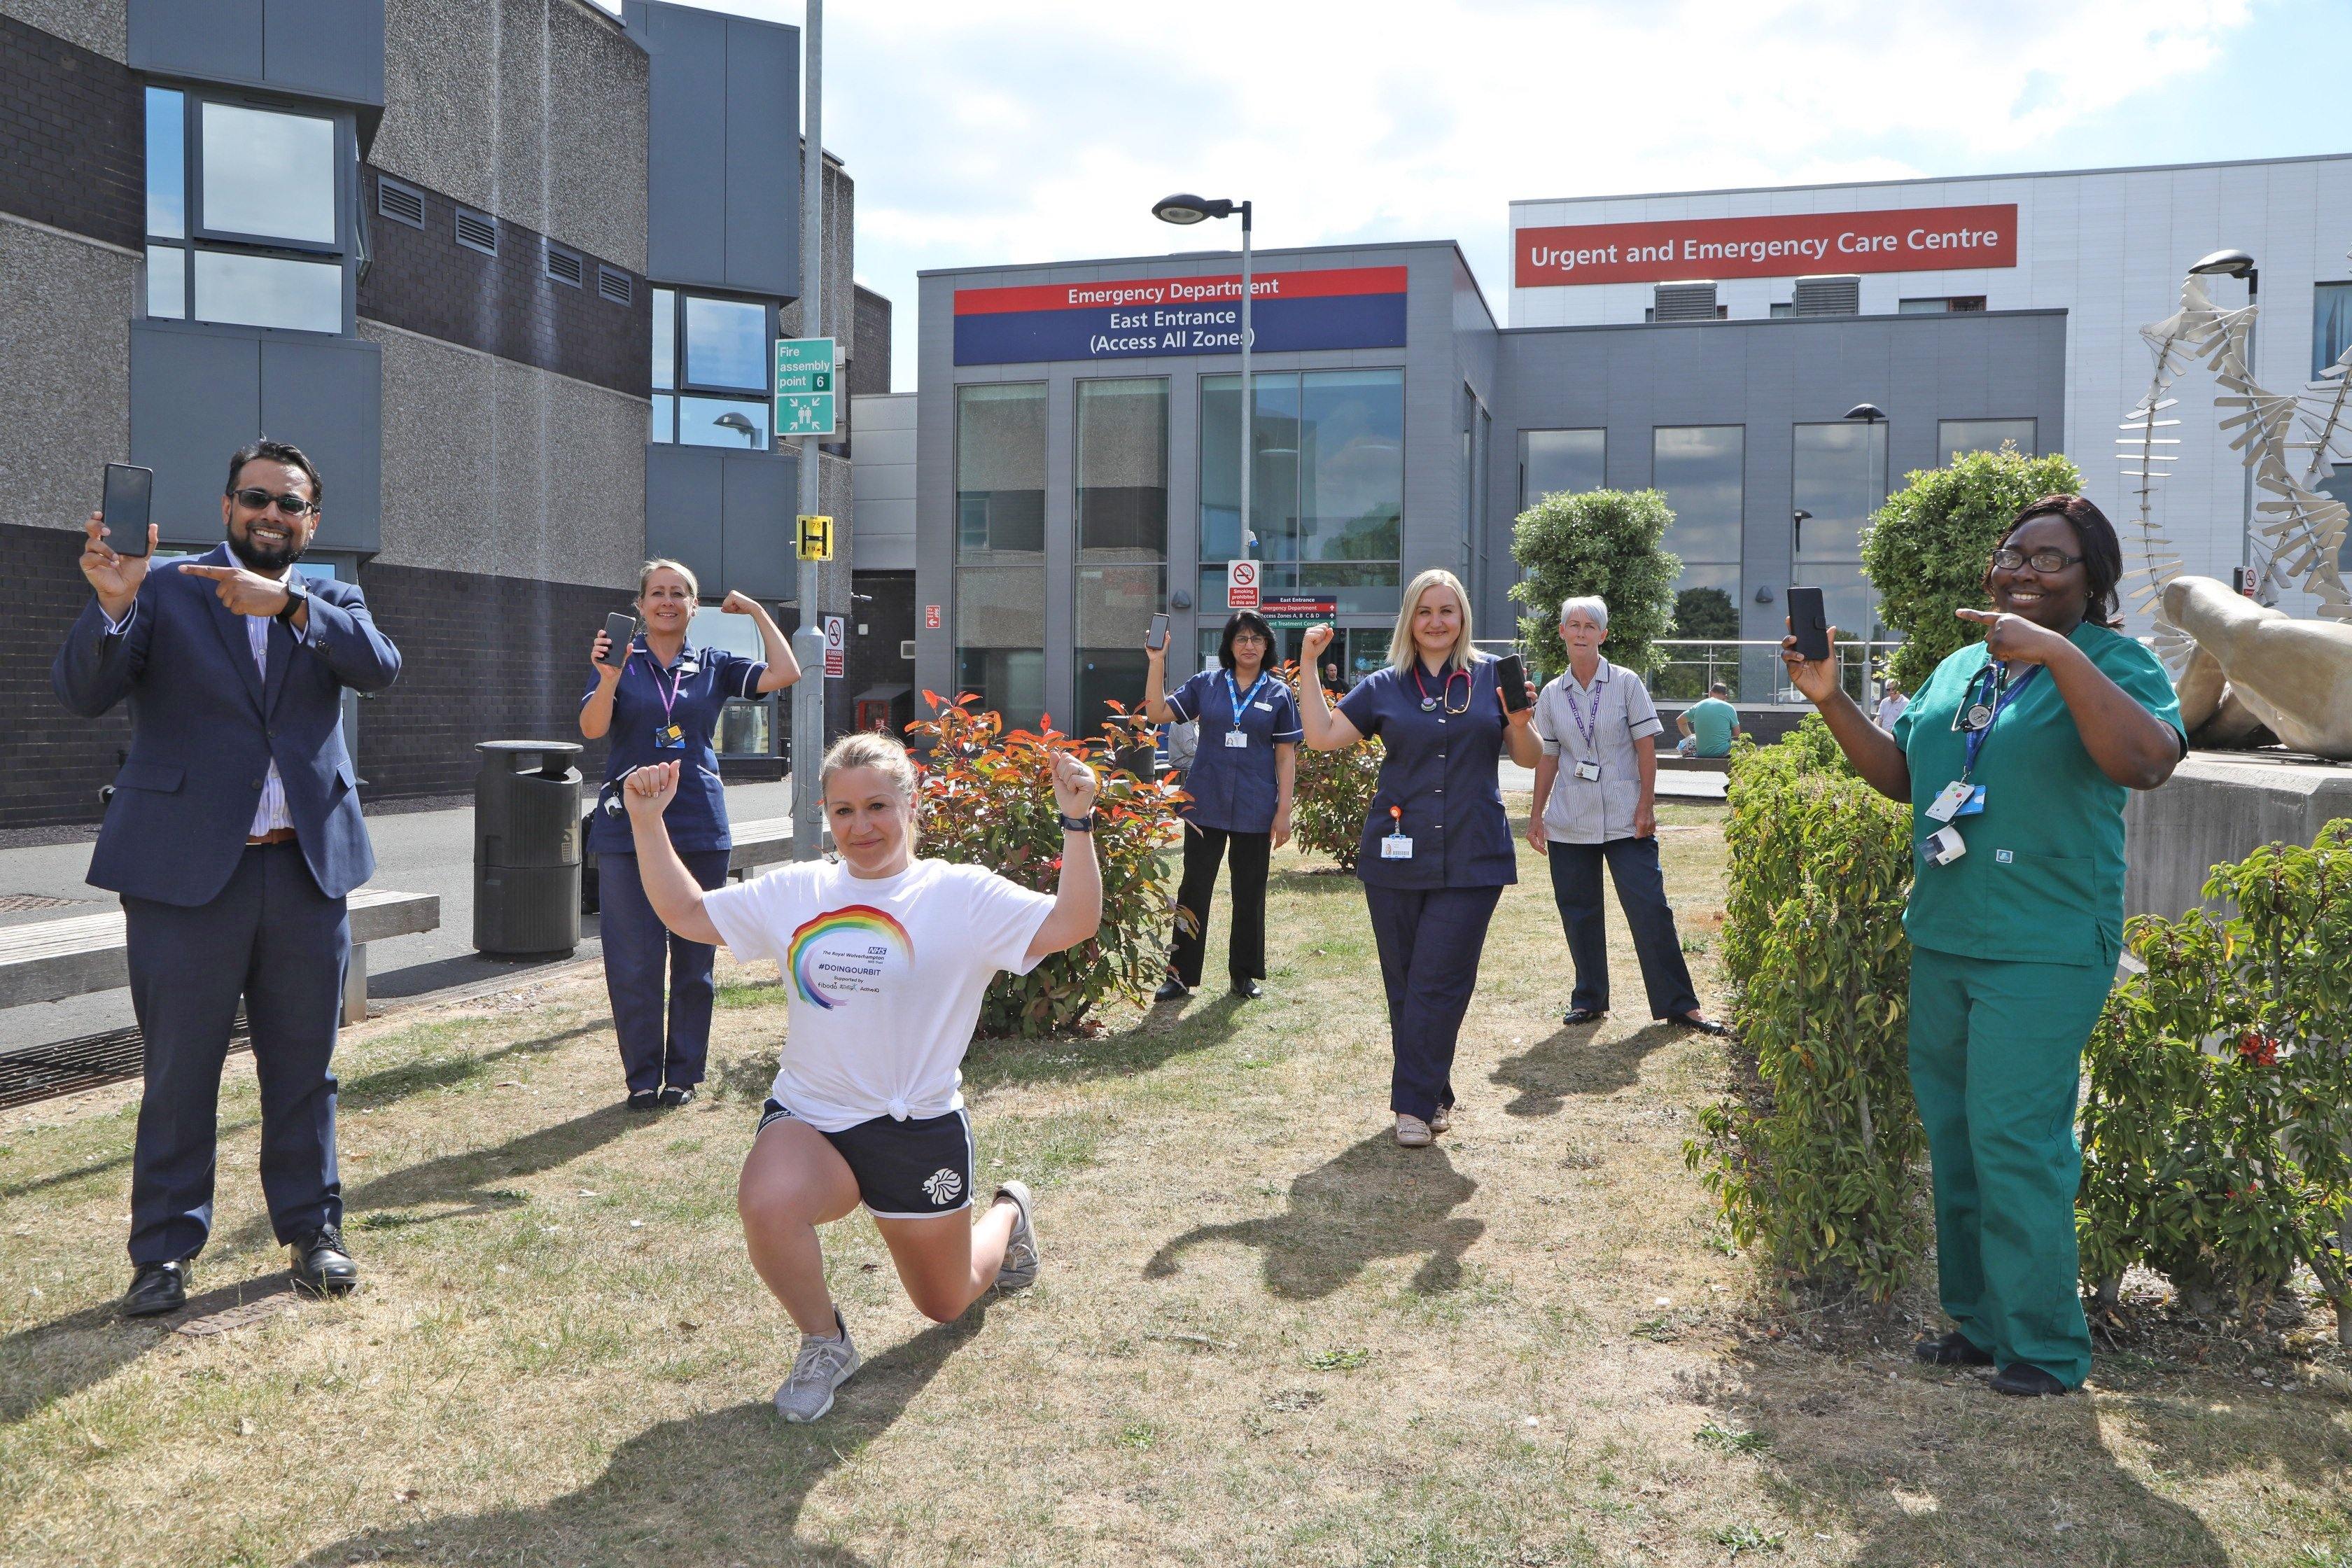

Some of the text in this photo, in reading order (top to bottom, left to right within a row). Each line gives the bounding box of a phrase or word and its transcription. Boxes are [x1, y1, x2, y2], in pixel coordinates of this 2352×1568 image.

[1532, 228, 1998, 271] Urgent and Emergency Care Centre
[1068, 279, 1278, 305] Emergency Department
[1110, 311, 1236, 329] East Entrance
[1091, 328, 1254, 354] (Access All Zone)
[780, 347, 799, 357] Fire
[780, 360, 830, 372] assembly
[780, 377, 823, 388] point 6
[818, 963, 881, 976] #DOINGOURBIT
